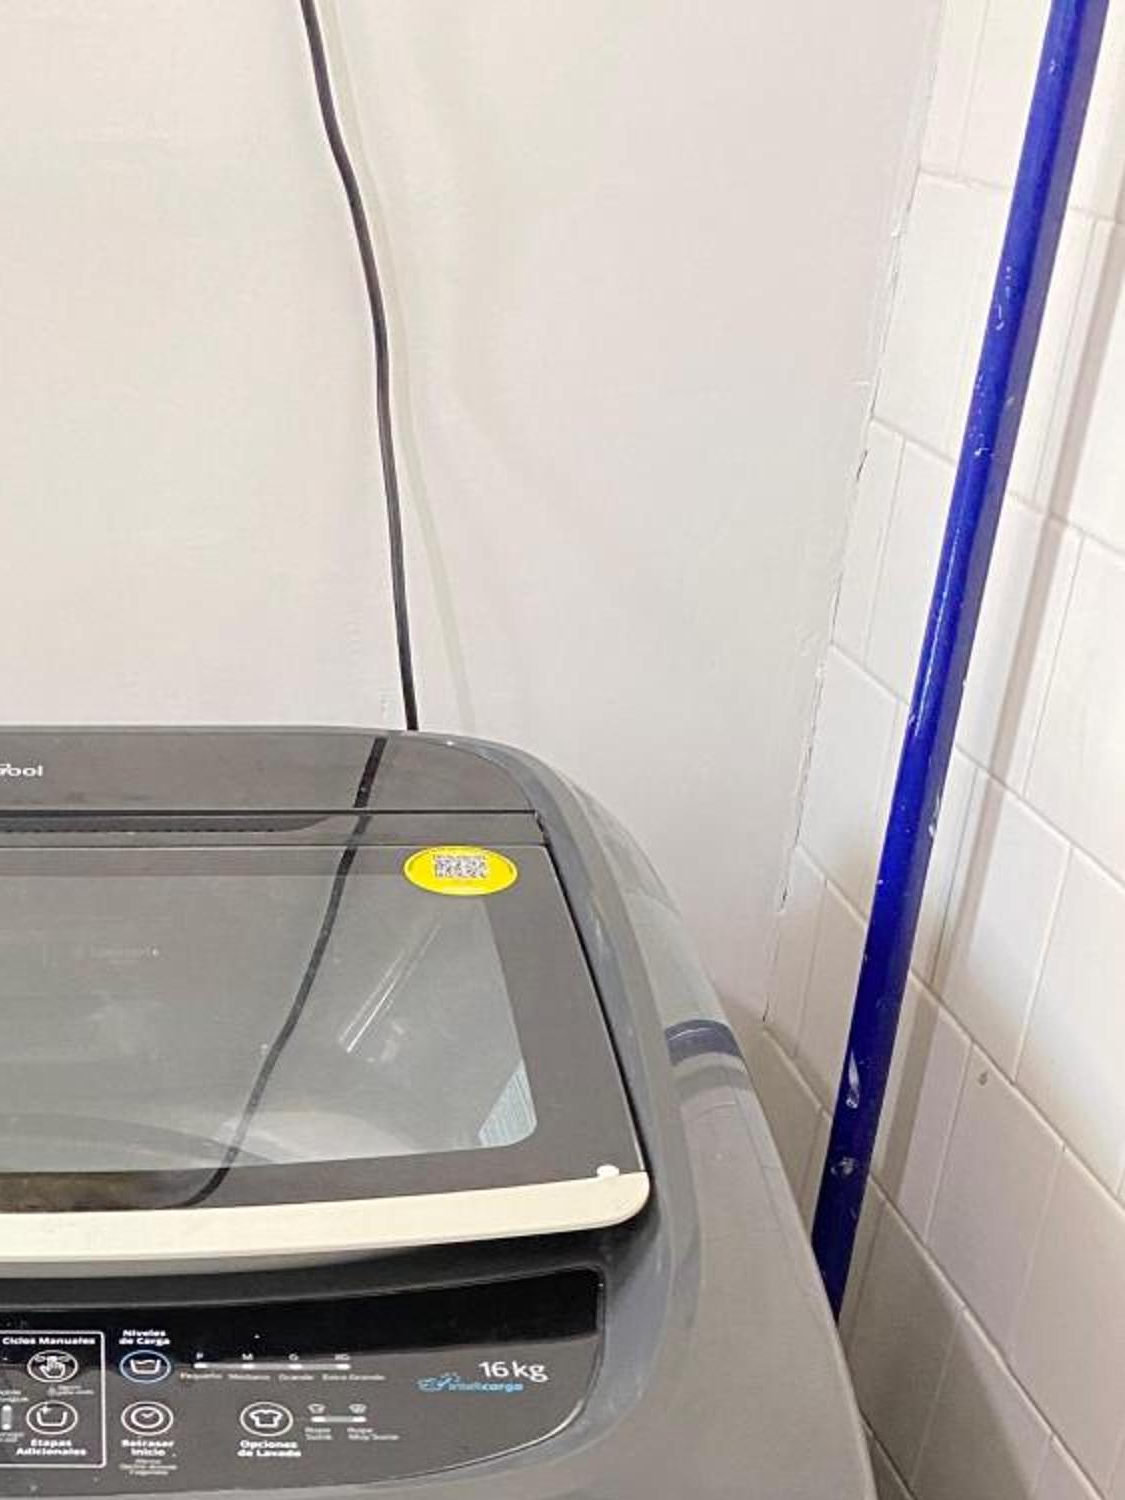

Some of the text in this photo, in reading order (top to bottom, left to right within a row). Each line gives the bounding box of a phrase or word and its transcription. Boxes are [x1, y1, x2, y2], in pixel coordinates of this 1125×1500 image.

[122, 1329, 166, 1337] Niveles
[2, 1336, 96, 1345] Ciclos Manuales
[118, 1337, 171, 1347] de Carga
[479, 1360, 549, 1383] 16 kg
[30, 1439, 72, 1448] Etapas
[120, 1439, 175, 1448] Retrasar
[239, 1440, 299, 1449] Opciones
[15, 1447, 87, 1456] Adicionales
[131, 1448, 166, 1457] Inicio
[237, 1449, 302, 1457] de Lavado
